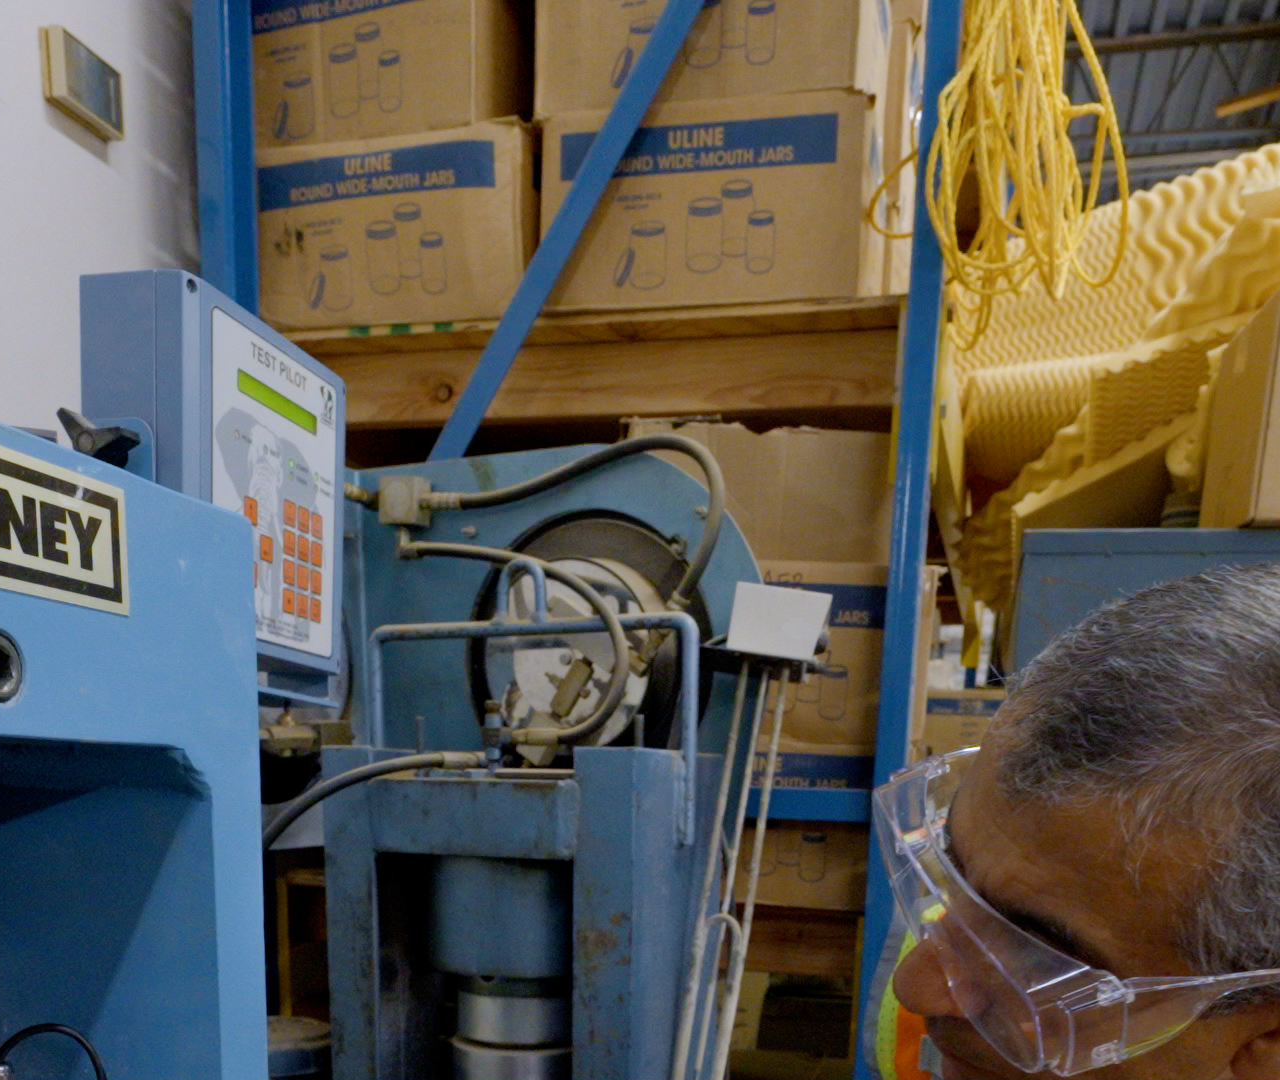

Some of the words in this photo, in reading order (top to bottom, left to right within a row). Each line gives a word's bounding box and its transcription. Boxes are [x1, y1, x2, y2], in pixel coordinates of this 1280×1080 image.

[667, 127, 725, 149] ULINE
[343, 153, 392, 175] ULINE
[614, 155, 653, 173] OUND
[657, 150, 754, 170] WIDE-MOUTH
[758, 146, 795, 163] JARS
[290, 185, 333, 203] ROUND
[336, 173, 420, 197] WIDE-MOUTH
[423, 169, 455, 187] JARS
[251, 342, 277, 372] TEST
[280, 362, 307, 392] PILOT
[834, 610, 870, 625] JARS
